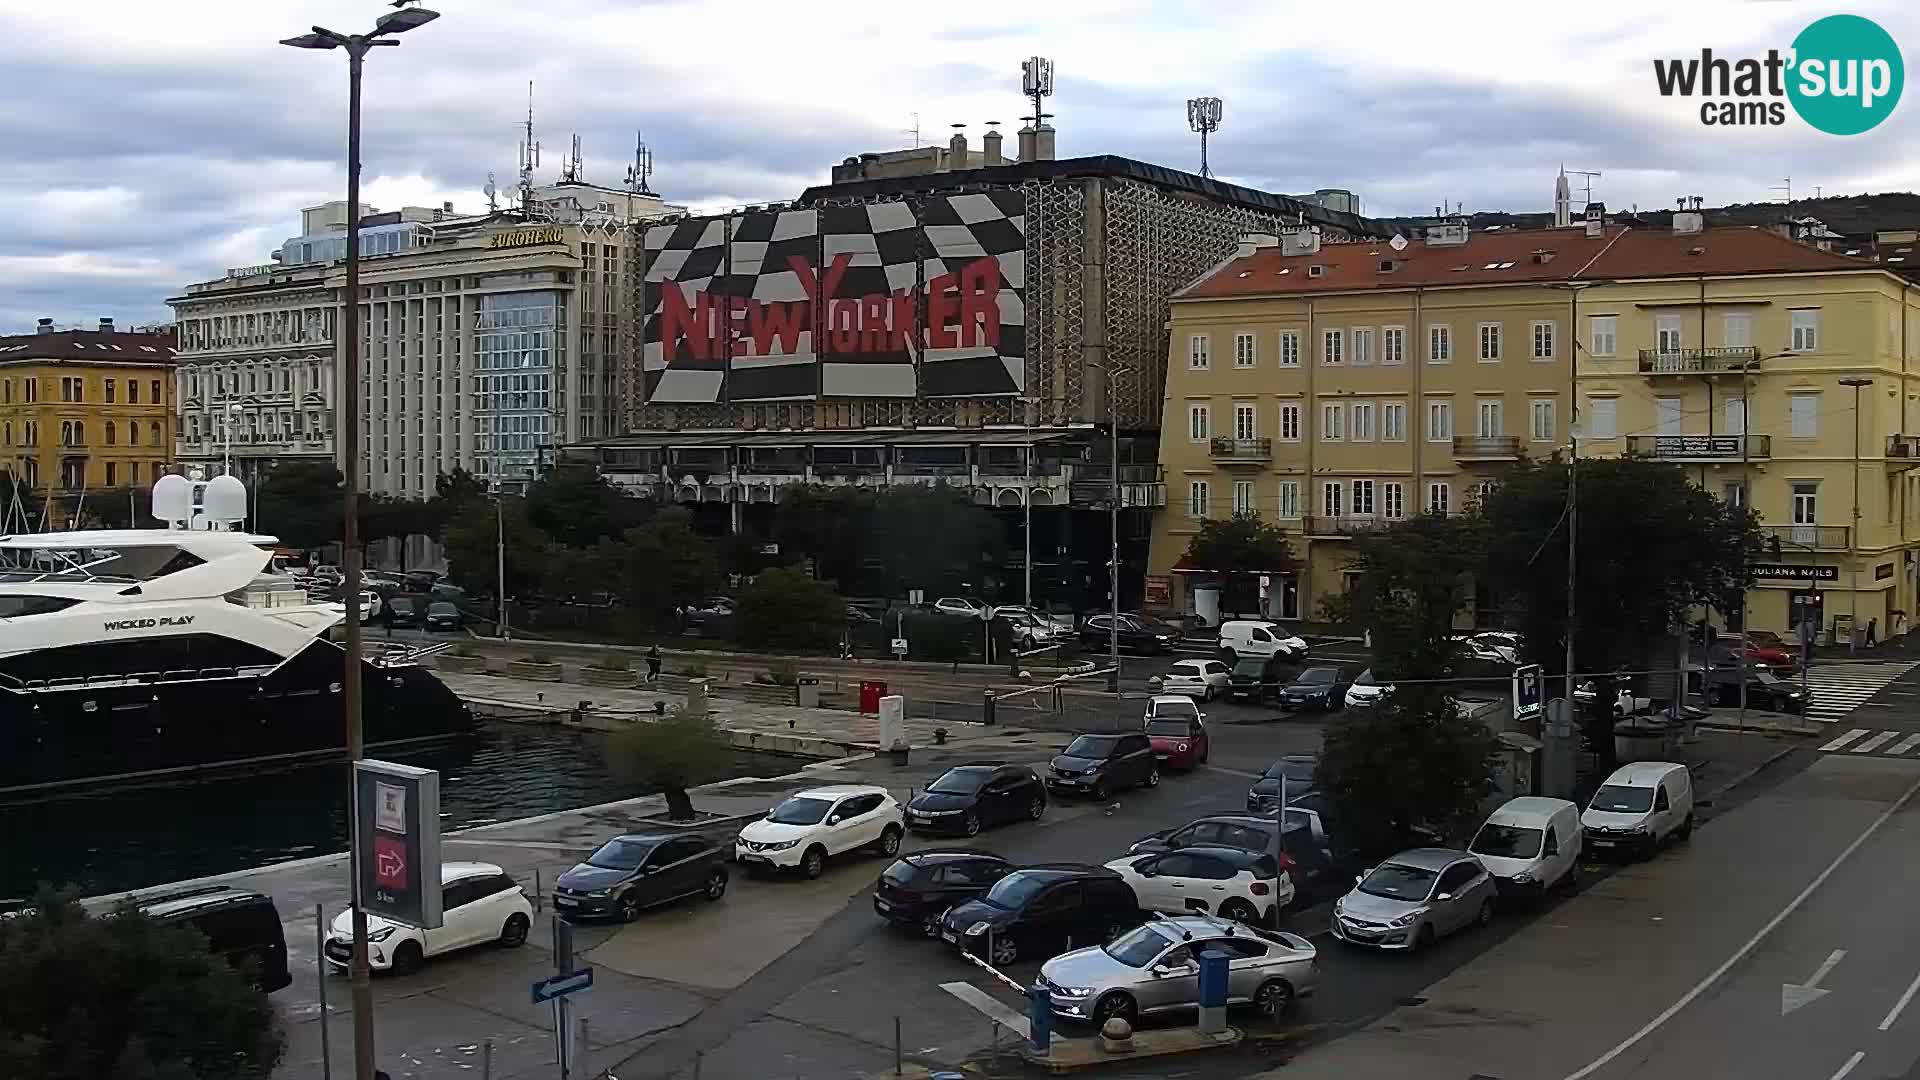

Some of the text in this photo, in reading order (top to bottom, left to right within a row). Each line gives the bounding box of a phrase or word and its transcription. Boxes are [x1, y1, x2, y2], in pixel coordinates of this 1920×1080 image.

[1751, 568, 1796, 576] JULIANA
[104, 616, 195, 631] WICKED PLAY
